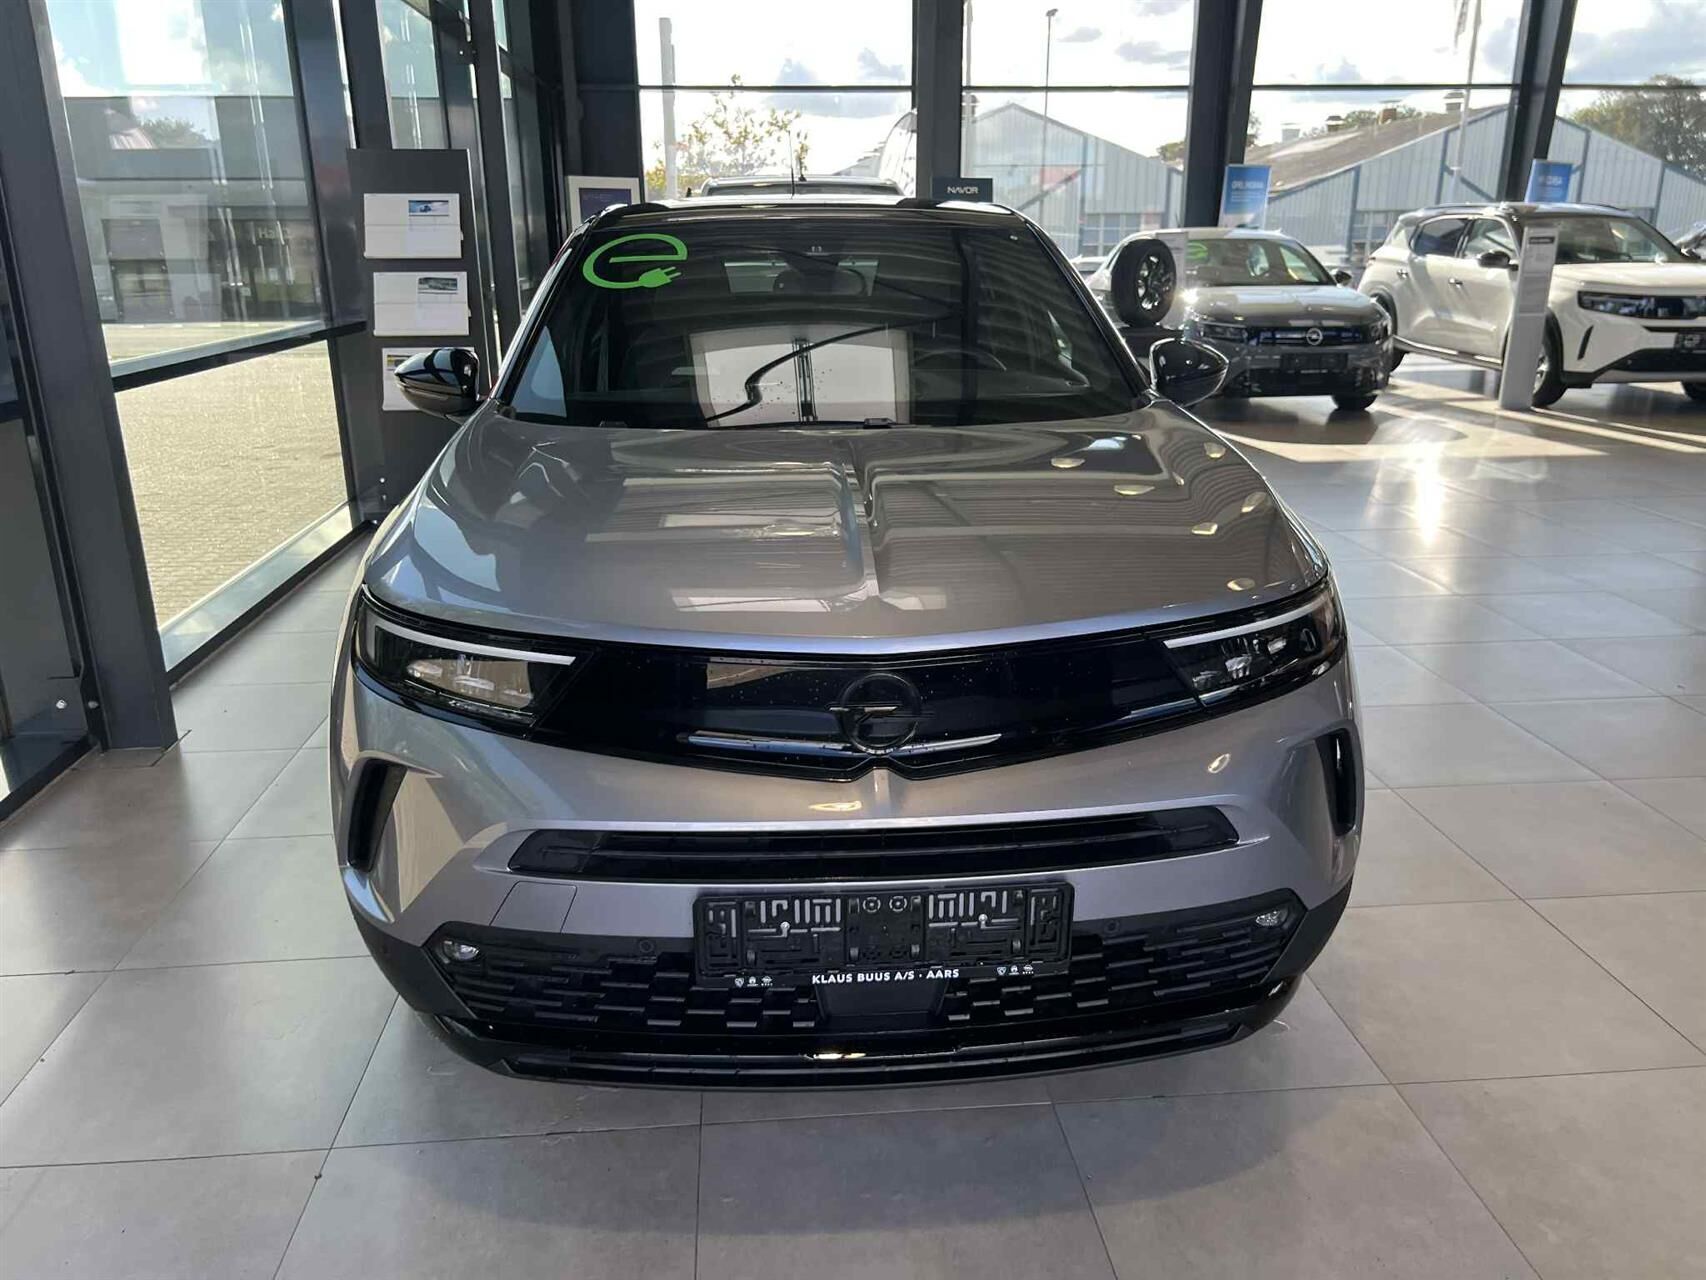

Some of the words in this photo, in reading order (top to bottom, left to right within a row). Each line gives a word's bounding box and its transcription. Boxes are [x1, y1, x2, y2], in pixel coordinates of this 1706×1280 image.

[812, 973, 853, 984] KLAUS
[857, 971, 891, 983] BUUS
[895, 970, 915, 981] A/S
[926, 968, 960, 979] AARS
